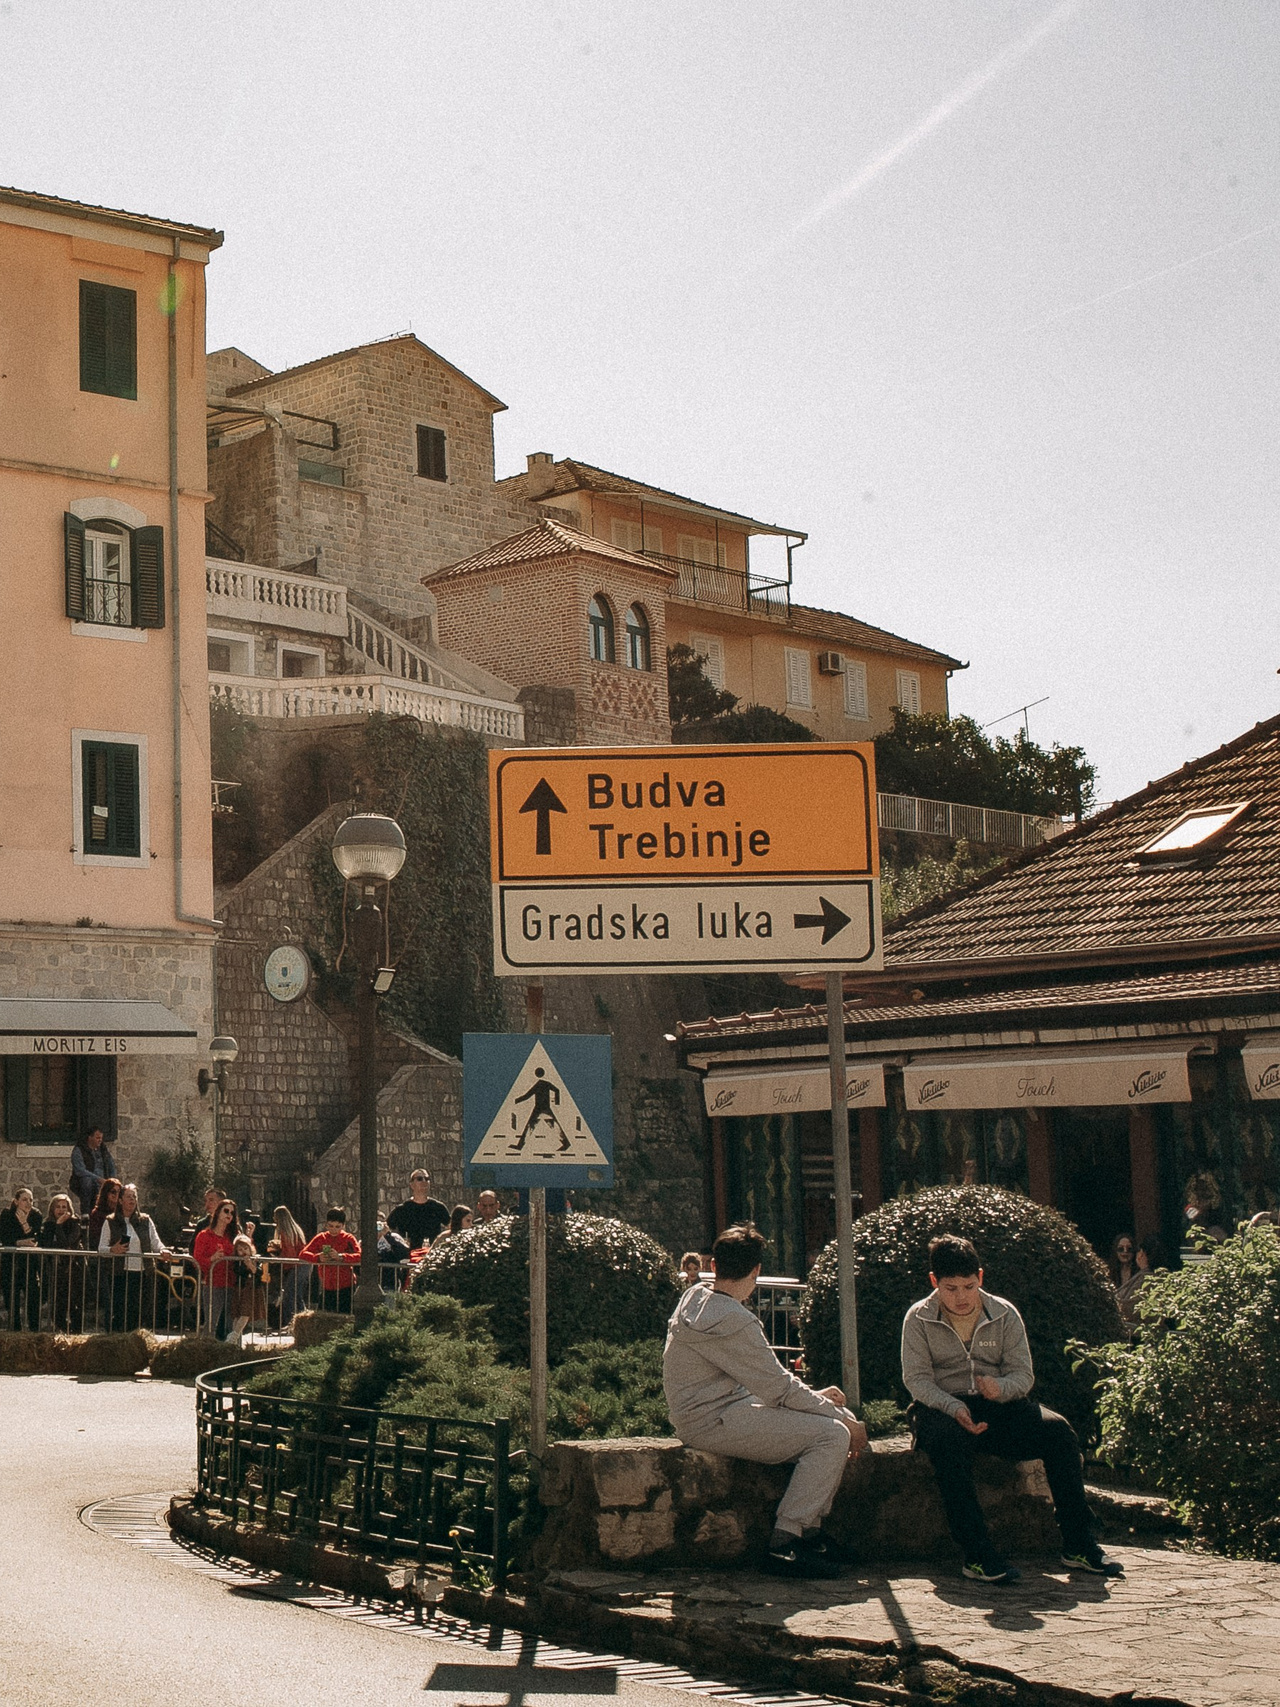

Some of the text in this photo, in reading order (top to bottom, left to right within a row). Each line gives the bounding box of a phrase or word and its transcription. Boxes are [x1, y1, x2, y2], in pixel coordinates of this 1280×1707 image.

[587, 772, 726, 809] Budva
[589, 821, 771, 867] Trebinje
[522, 901, 773, 942] Gradska luka
[33, 1038, 127, 1052] MORITZ EIS
[772, 1085, 803, 1106] Touch
[1016, 1076, 1056, 1099] Touch
